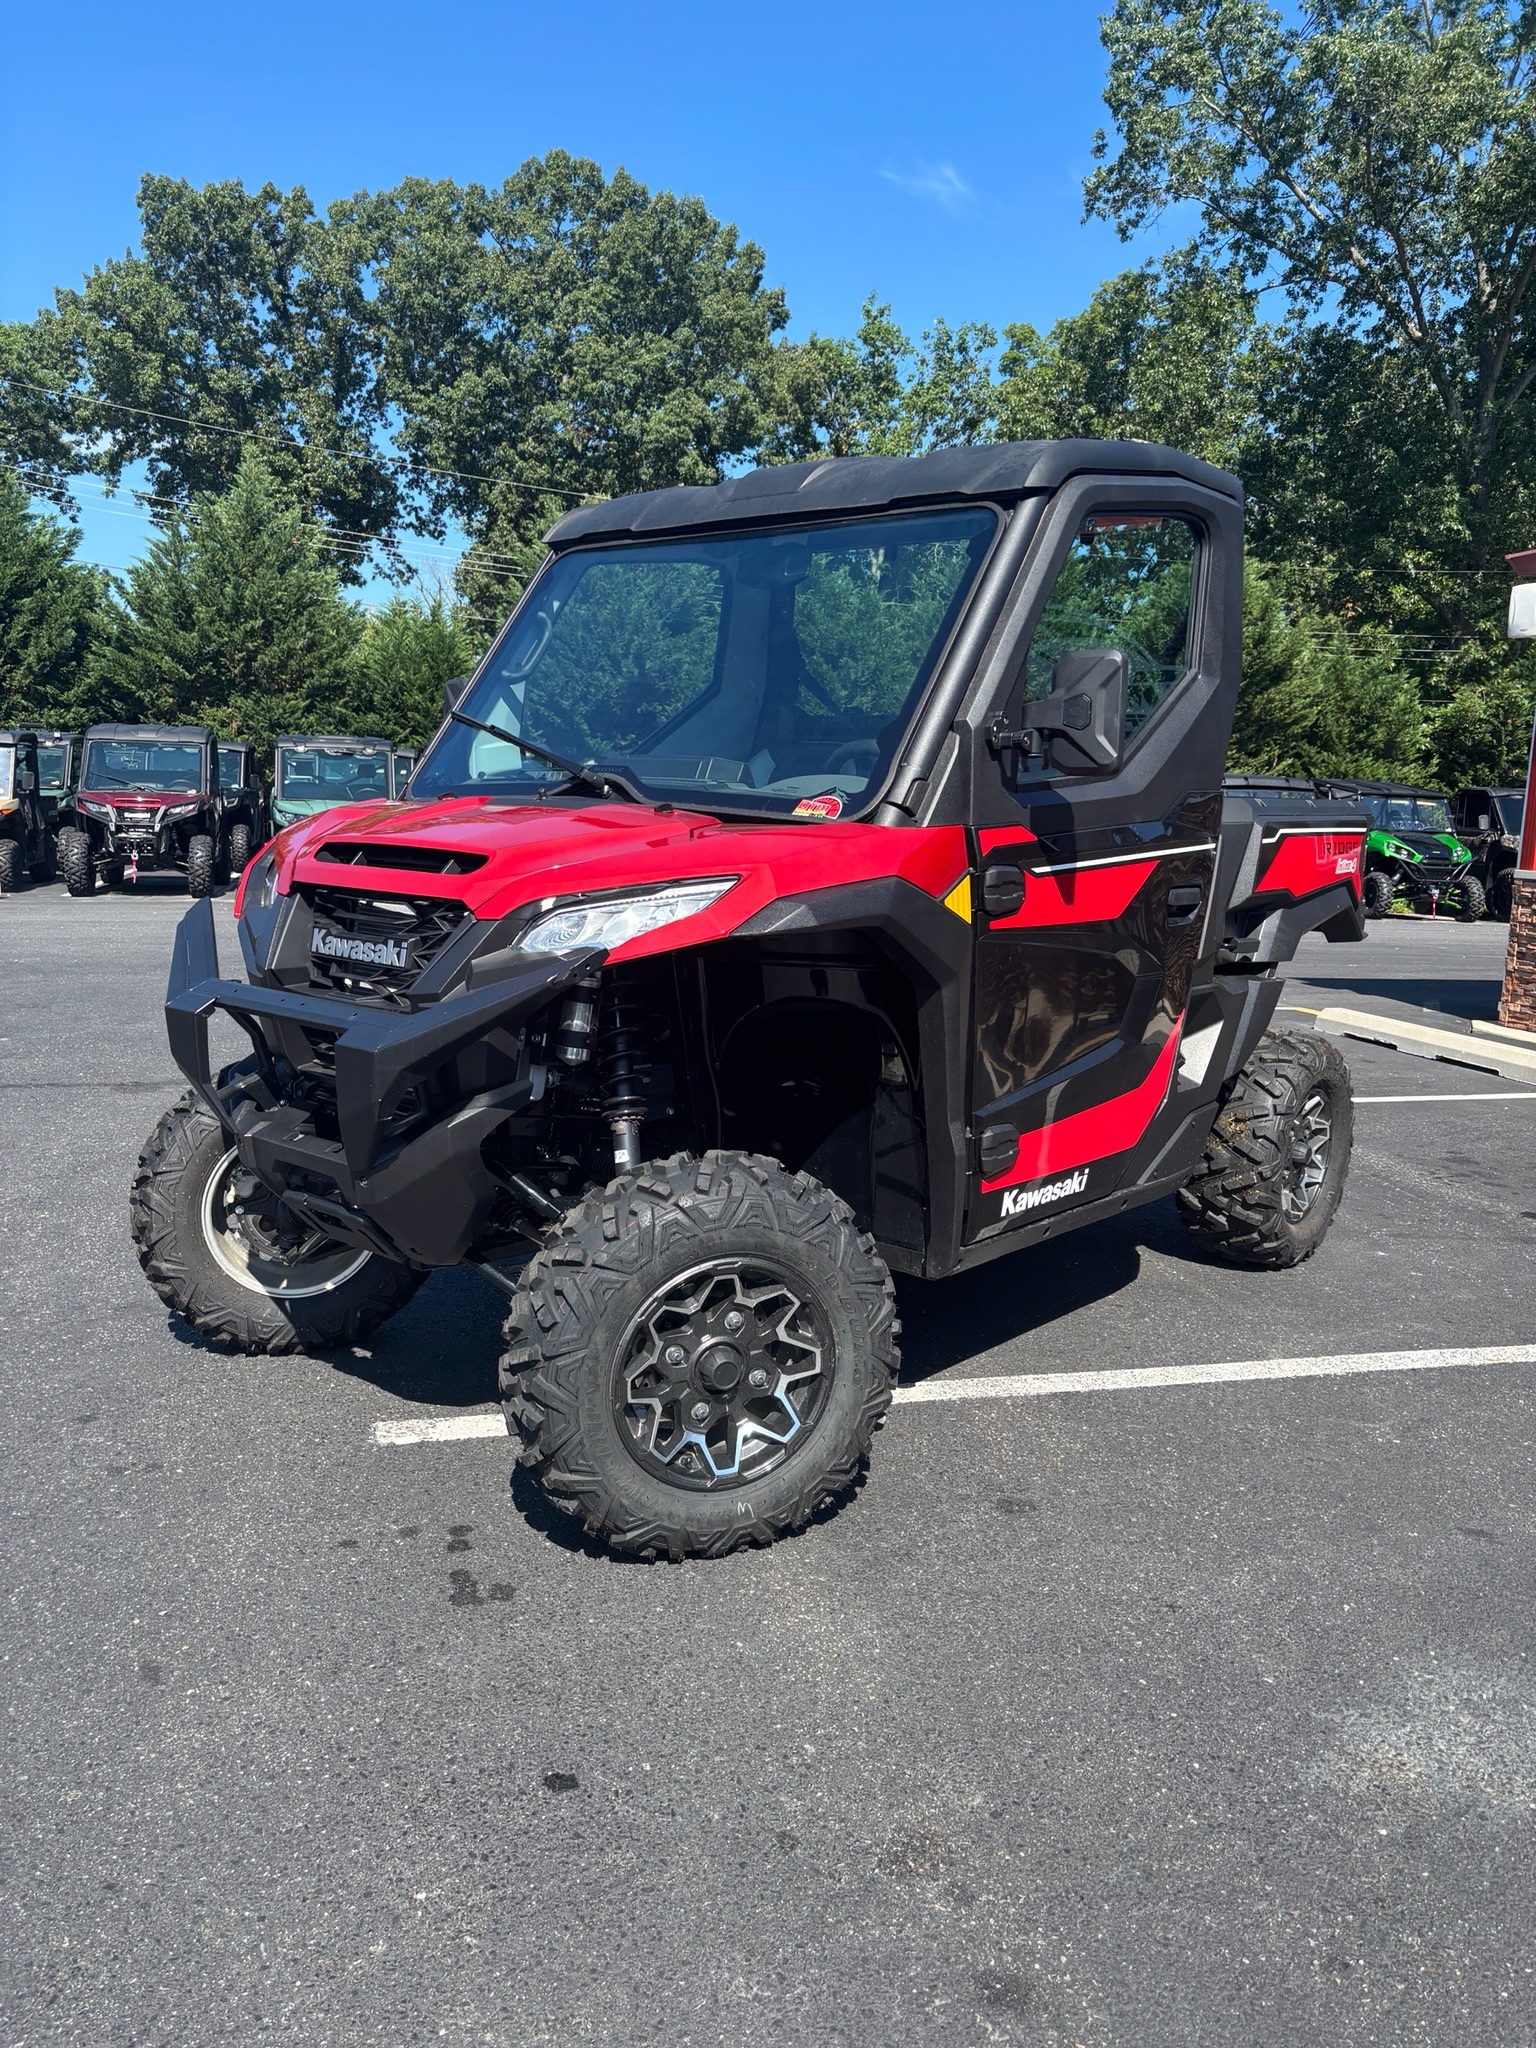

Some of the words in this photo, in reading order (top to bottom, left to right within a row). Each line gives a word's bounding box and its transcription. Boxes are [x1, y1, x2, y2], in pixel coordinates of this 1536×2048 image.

[1323, 841, 1359, 855] RIDGE
[311, 927, 409, 968] Kawasaki
[1000, 1167, 1090, 1217] Kawasaki
